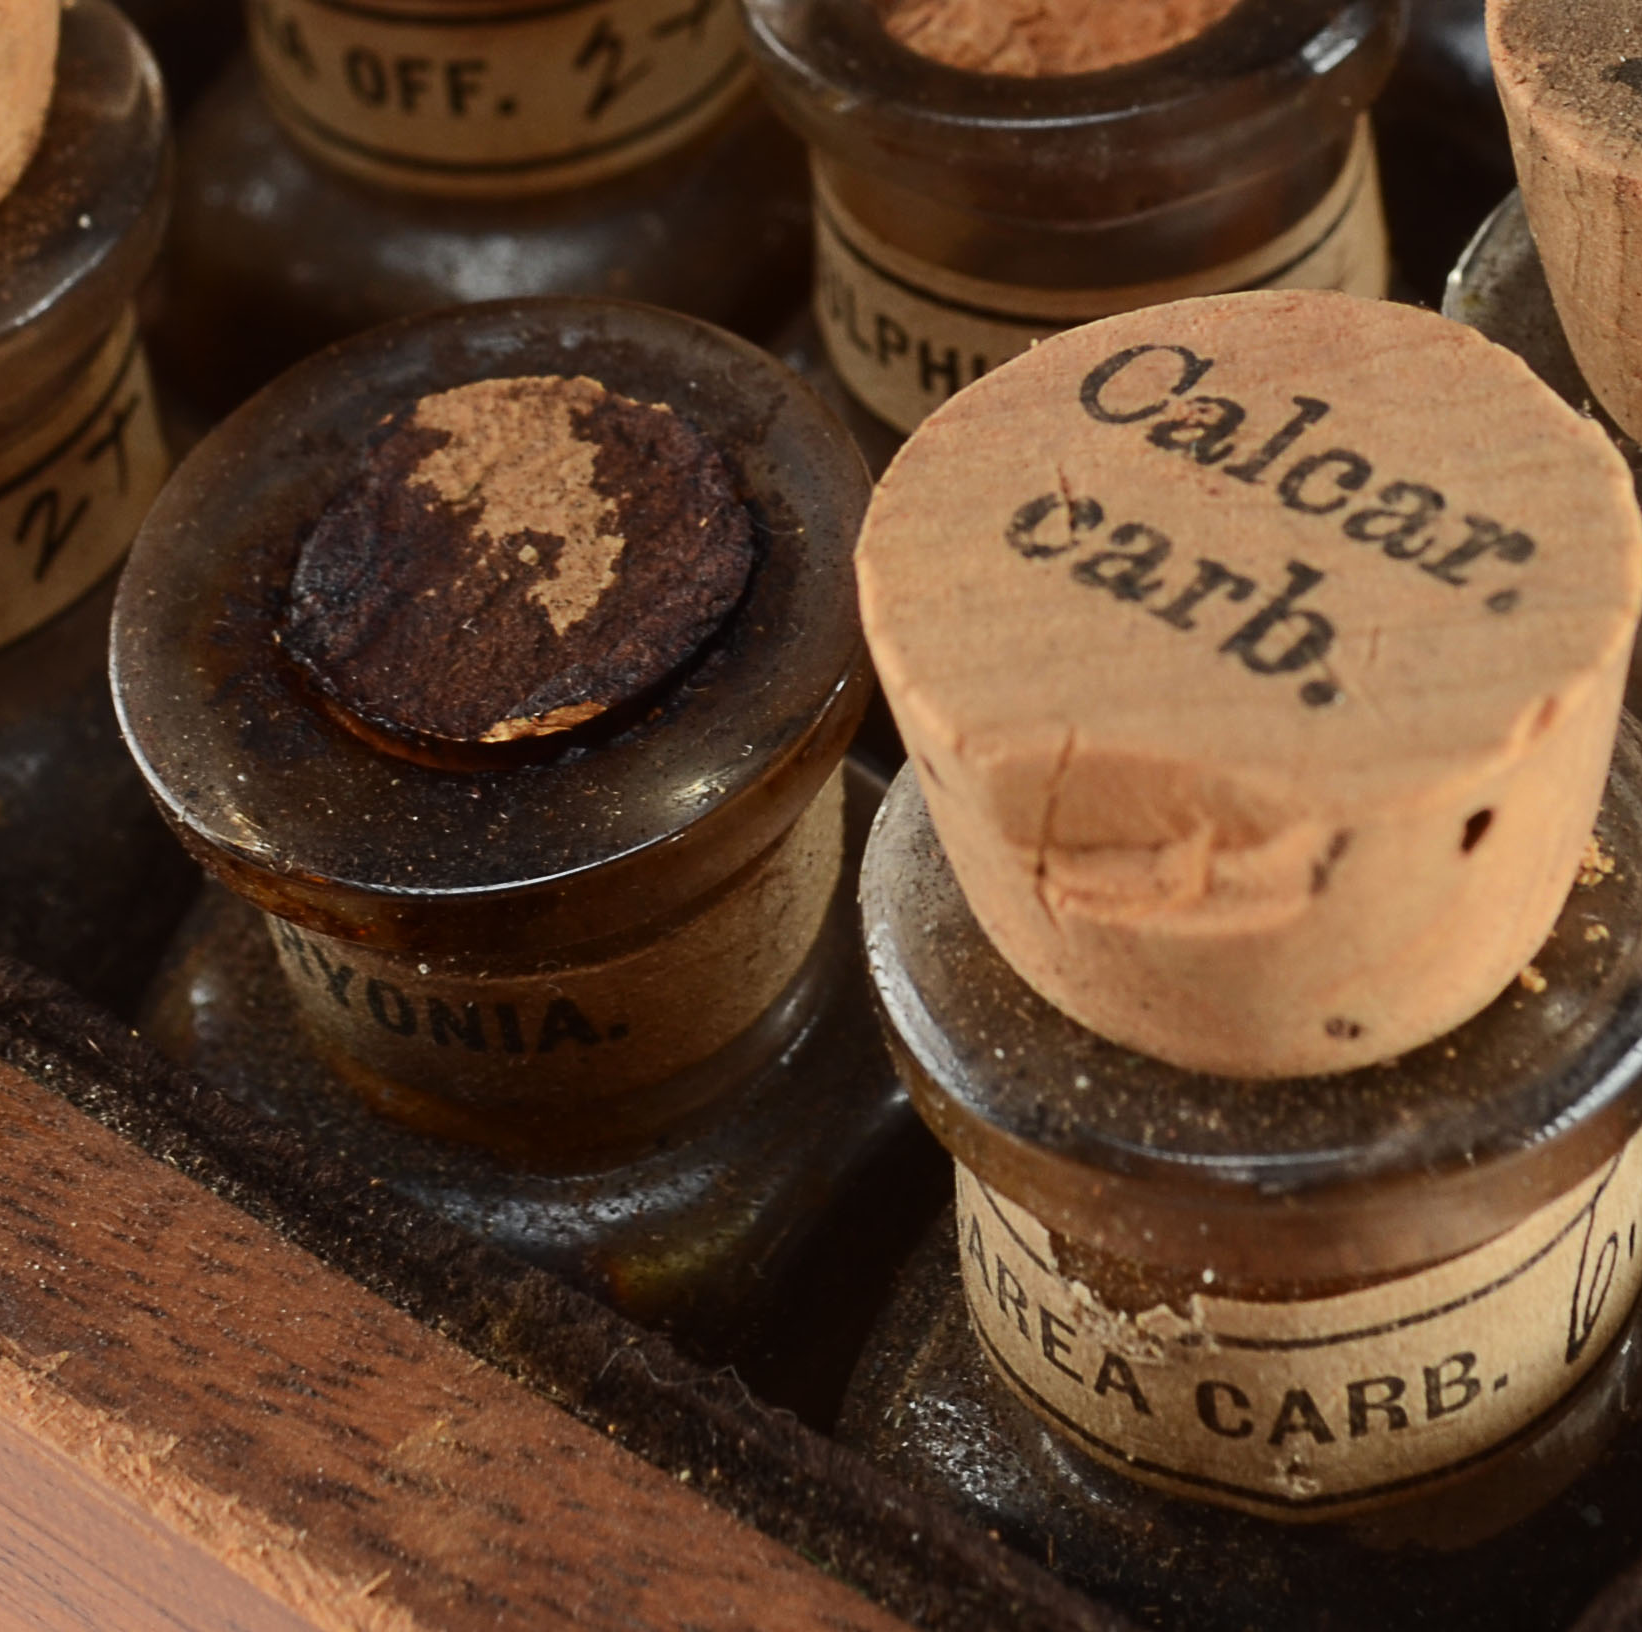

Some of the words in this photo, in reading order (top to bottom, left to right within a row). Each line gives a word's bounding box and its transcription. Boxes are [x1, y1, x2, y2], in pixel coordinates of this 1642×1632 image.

[339, 41, 520, 120] OFF.
[1078, 342, 1537, 615] Calcar.
[1005, 490, 1345, 708] carb.
[1194, 1350, 1510, 1448] CARB.
